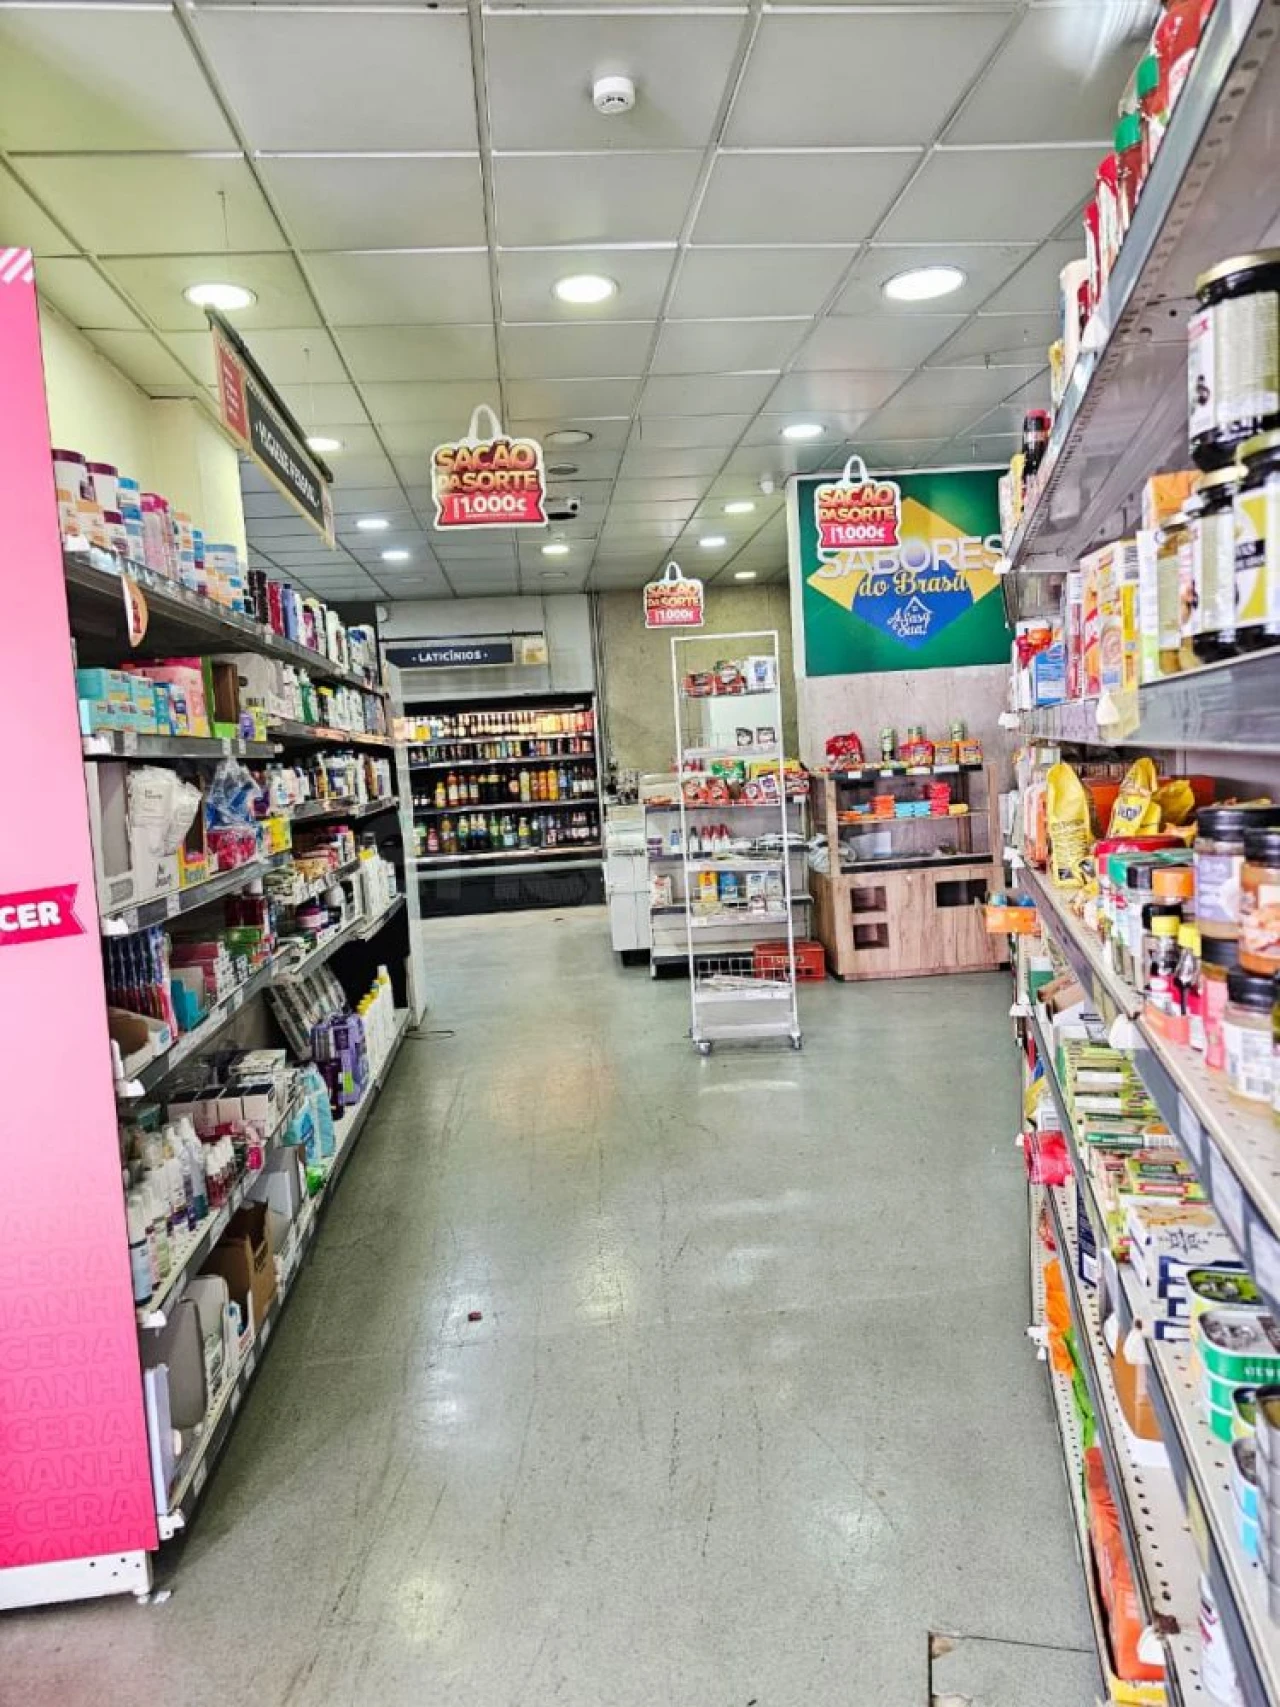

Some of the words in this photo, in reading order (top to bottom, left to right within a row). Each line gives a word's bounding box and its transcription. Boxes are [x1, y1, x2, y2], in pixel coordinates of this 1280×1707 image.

[461, 470, 539, 491] SORTE
[837, 505, 895, 523] SORTE
[817, 534, 1004, 579] SABORES
[859, 573, 889, 597] do
[893, 570, 967, 596] Brasil
[418, 650, 481, 663] LATICÍNIOS
[0, 900, 62, 931] CER
